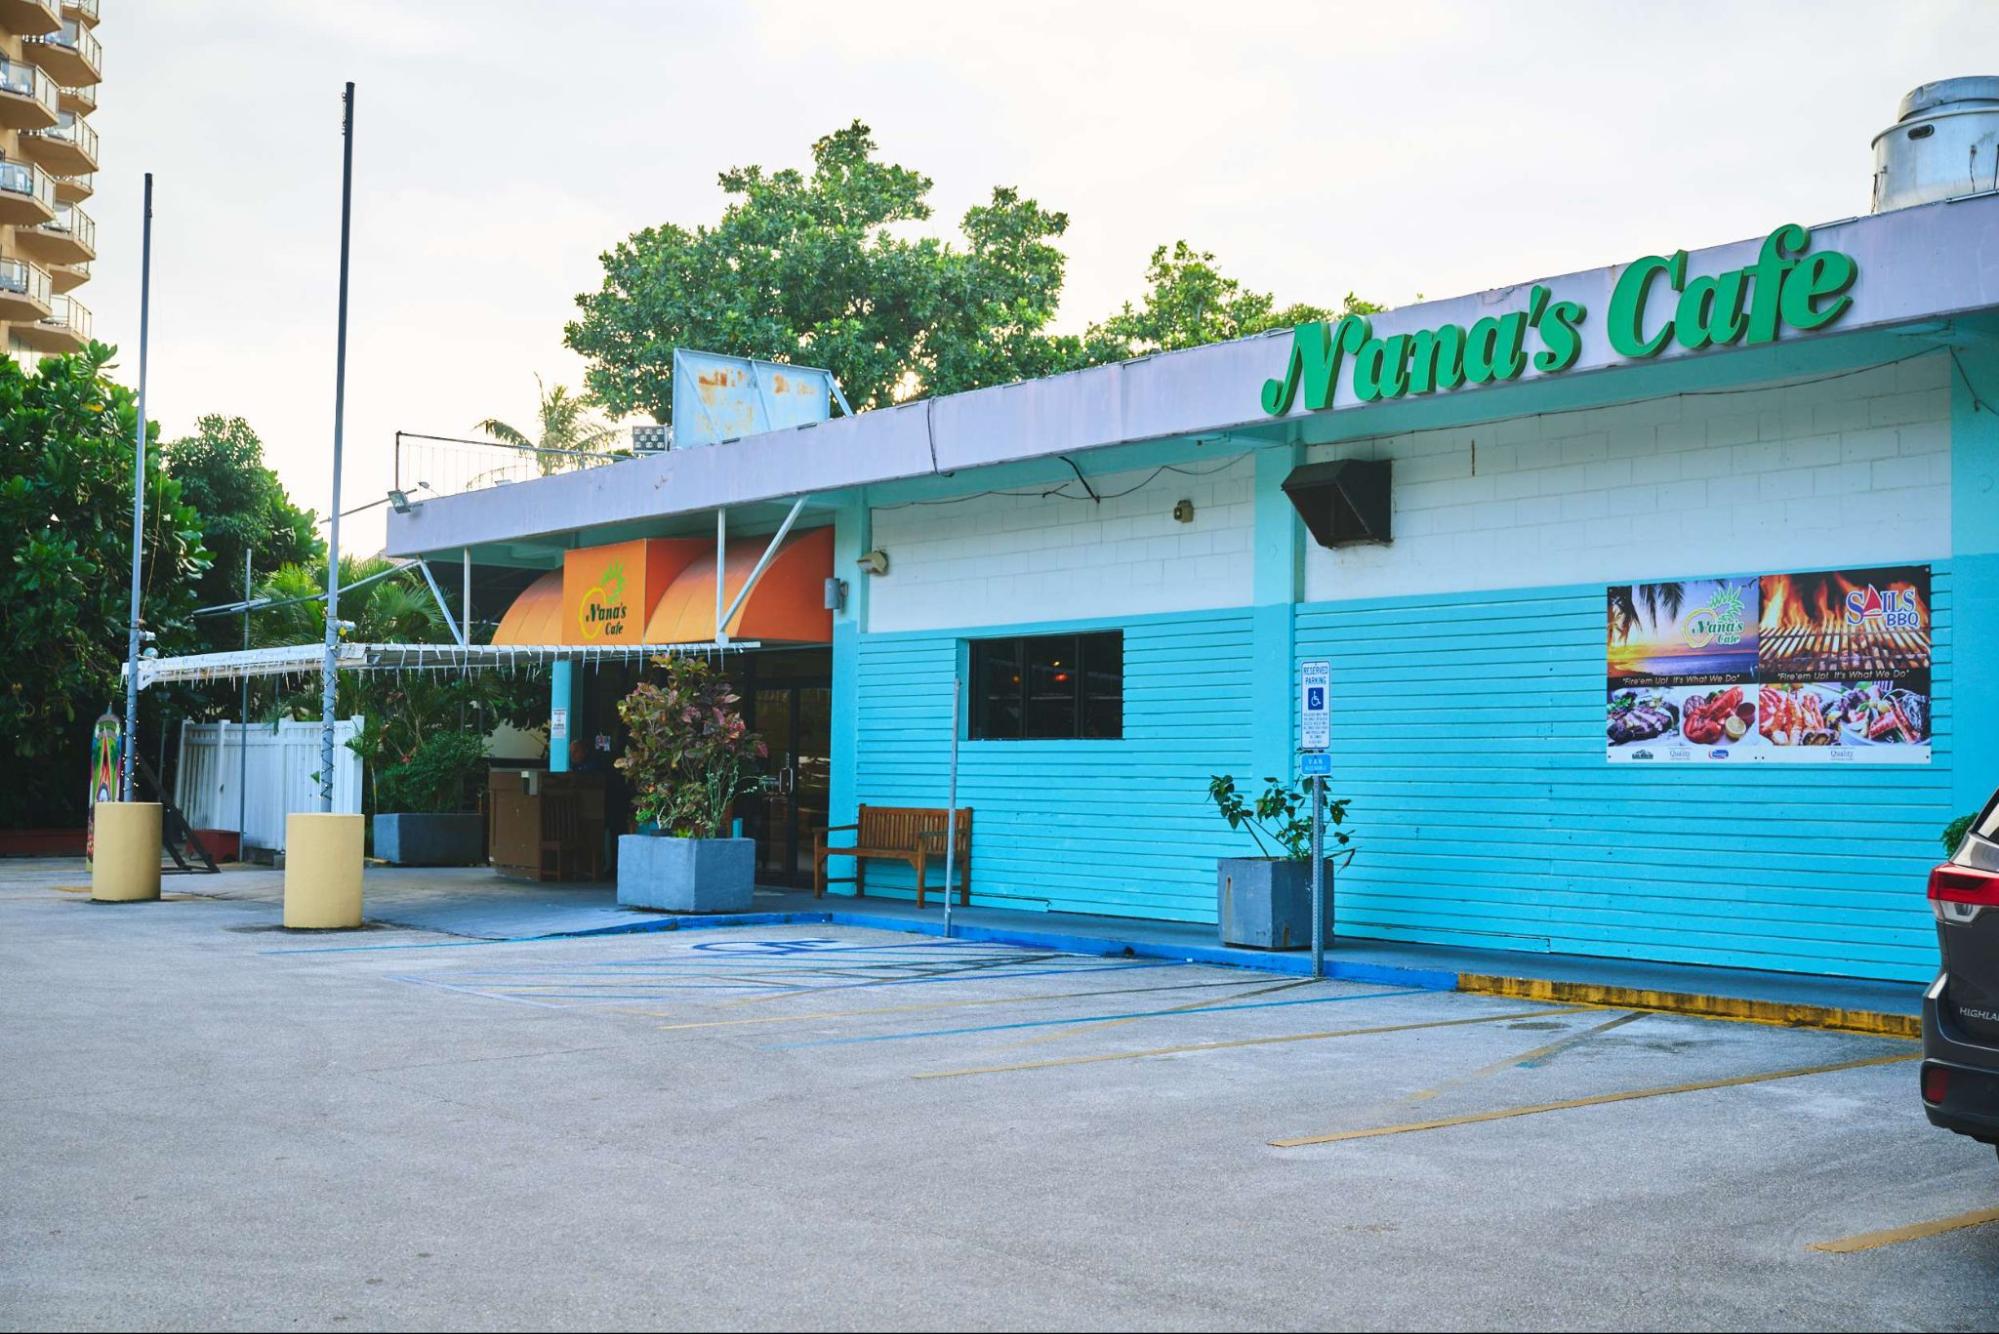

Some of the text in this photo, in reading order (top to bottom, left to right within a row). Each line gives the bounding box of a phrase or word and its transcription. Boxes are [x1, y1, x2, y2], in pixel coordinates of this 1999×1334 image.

[1261, 223, 1858, 417] Nana's Cafe
[1846, 584, 1916, 624] SAILS
[586, 602, 627, 622] Nana's
[1692, 619, 1744, 633] Nana's
[1886, 612, 1919, 627] BBQ
[605, 622, 623, 635] Cafe
[1717, 633, 1740, 643] Cafe
[1303, 665, 1328, 675] RESERVED
[1849, 669, 1873, 678] What
[1875, 669, 1890, 677] We
[1305, 675, 1327, 685] PARKING
[1686, 674, 1707, 683] What
[1709, 673, 1723, 682] We
[1960, 1007, 1999, 1022] HIGHLA
